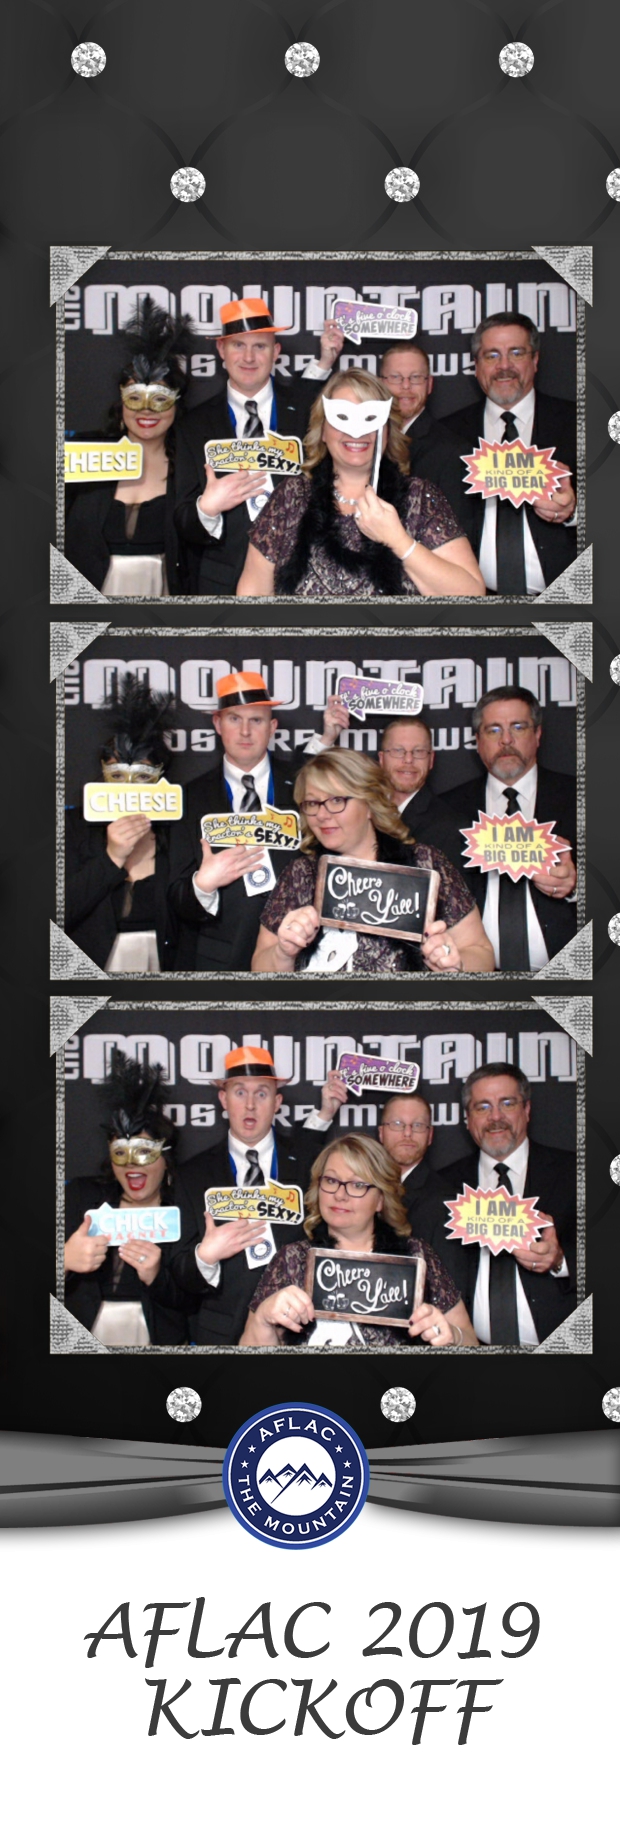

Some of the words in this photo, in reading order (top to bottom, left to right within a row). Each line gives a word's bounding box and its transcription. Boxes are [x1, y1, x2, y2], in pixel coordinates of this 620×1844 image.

[356, 310, 375, 324] five
[344, 320, 415, 334] SOMEWHERE
[207, 443, 230, 458] She
[230, 441, 266, 452] thinks
[267, 447, 285, 459] my
[256, 453, 301, 474] SEXY!
[492, 453, 498, 468] I
[505, 453, 535, 468] AM
[484, 476, 508, 488] BIG
[512, 476, 547, 489] DEAL
[361, 686, 380, 701] five
[349, 696, 420, 710] SOMEWHERE
[89, 791, 178, 813] CHEESE
[203, 817, 227, 832] She
[227, 814, 264, 826] thinks
[265, 821, 282, 833] my
[254, 827, 300, 849] SEXY!
[492, 826, 498, 842] I
[504, 826, 534, 842] AM
[483, 850, 506, 862] BIG
[511, 850, 546, 863] DEAL
[327, 866, 382, 899] Cheers
[360, 1063, 378, 1077] five
[347, 1073, 416, 1087] SOMEWHERE
[207, 1191, 230, 1206] She
[230, 1188, 267, 1200] thinks
[268, 1195, 285, 1207] my
[256, 1201, 302, 1223] SEXY!
[475, 1200, 481, 1216] I
[487, 1200, 517, 1217] AM
[98, 1211, 168, 1233] CHICK
[466, 1222, 488, 1235] BIG
[493, 1224, 527, 1238] DEAL
[316, 1259, 370, 1291] Cheers
